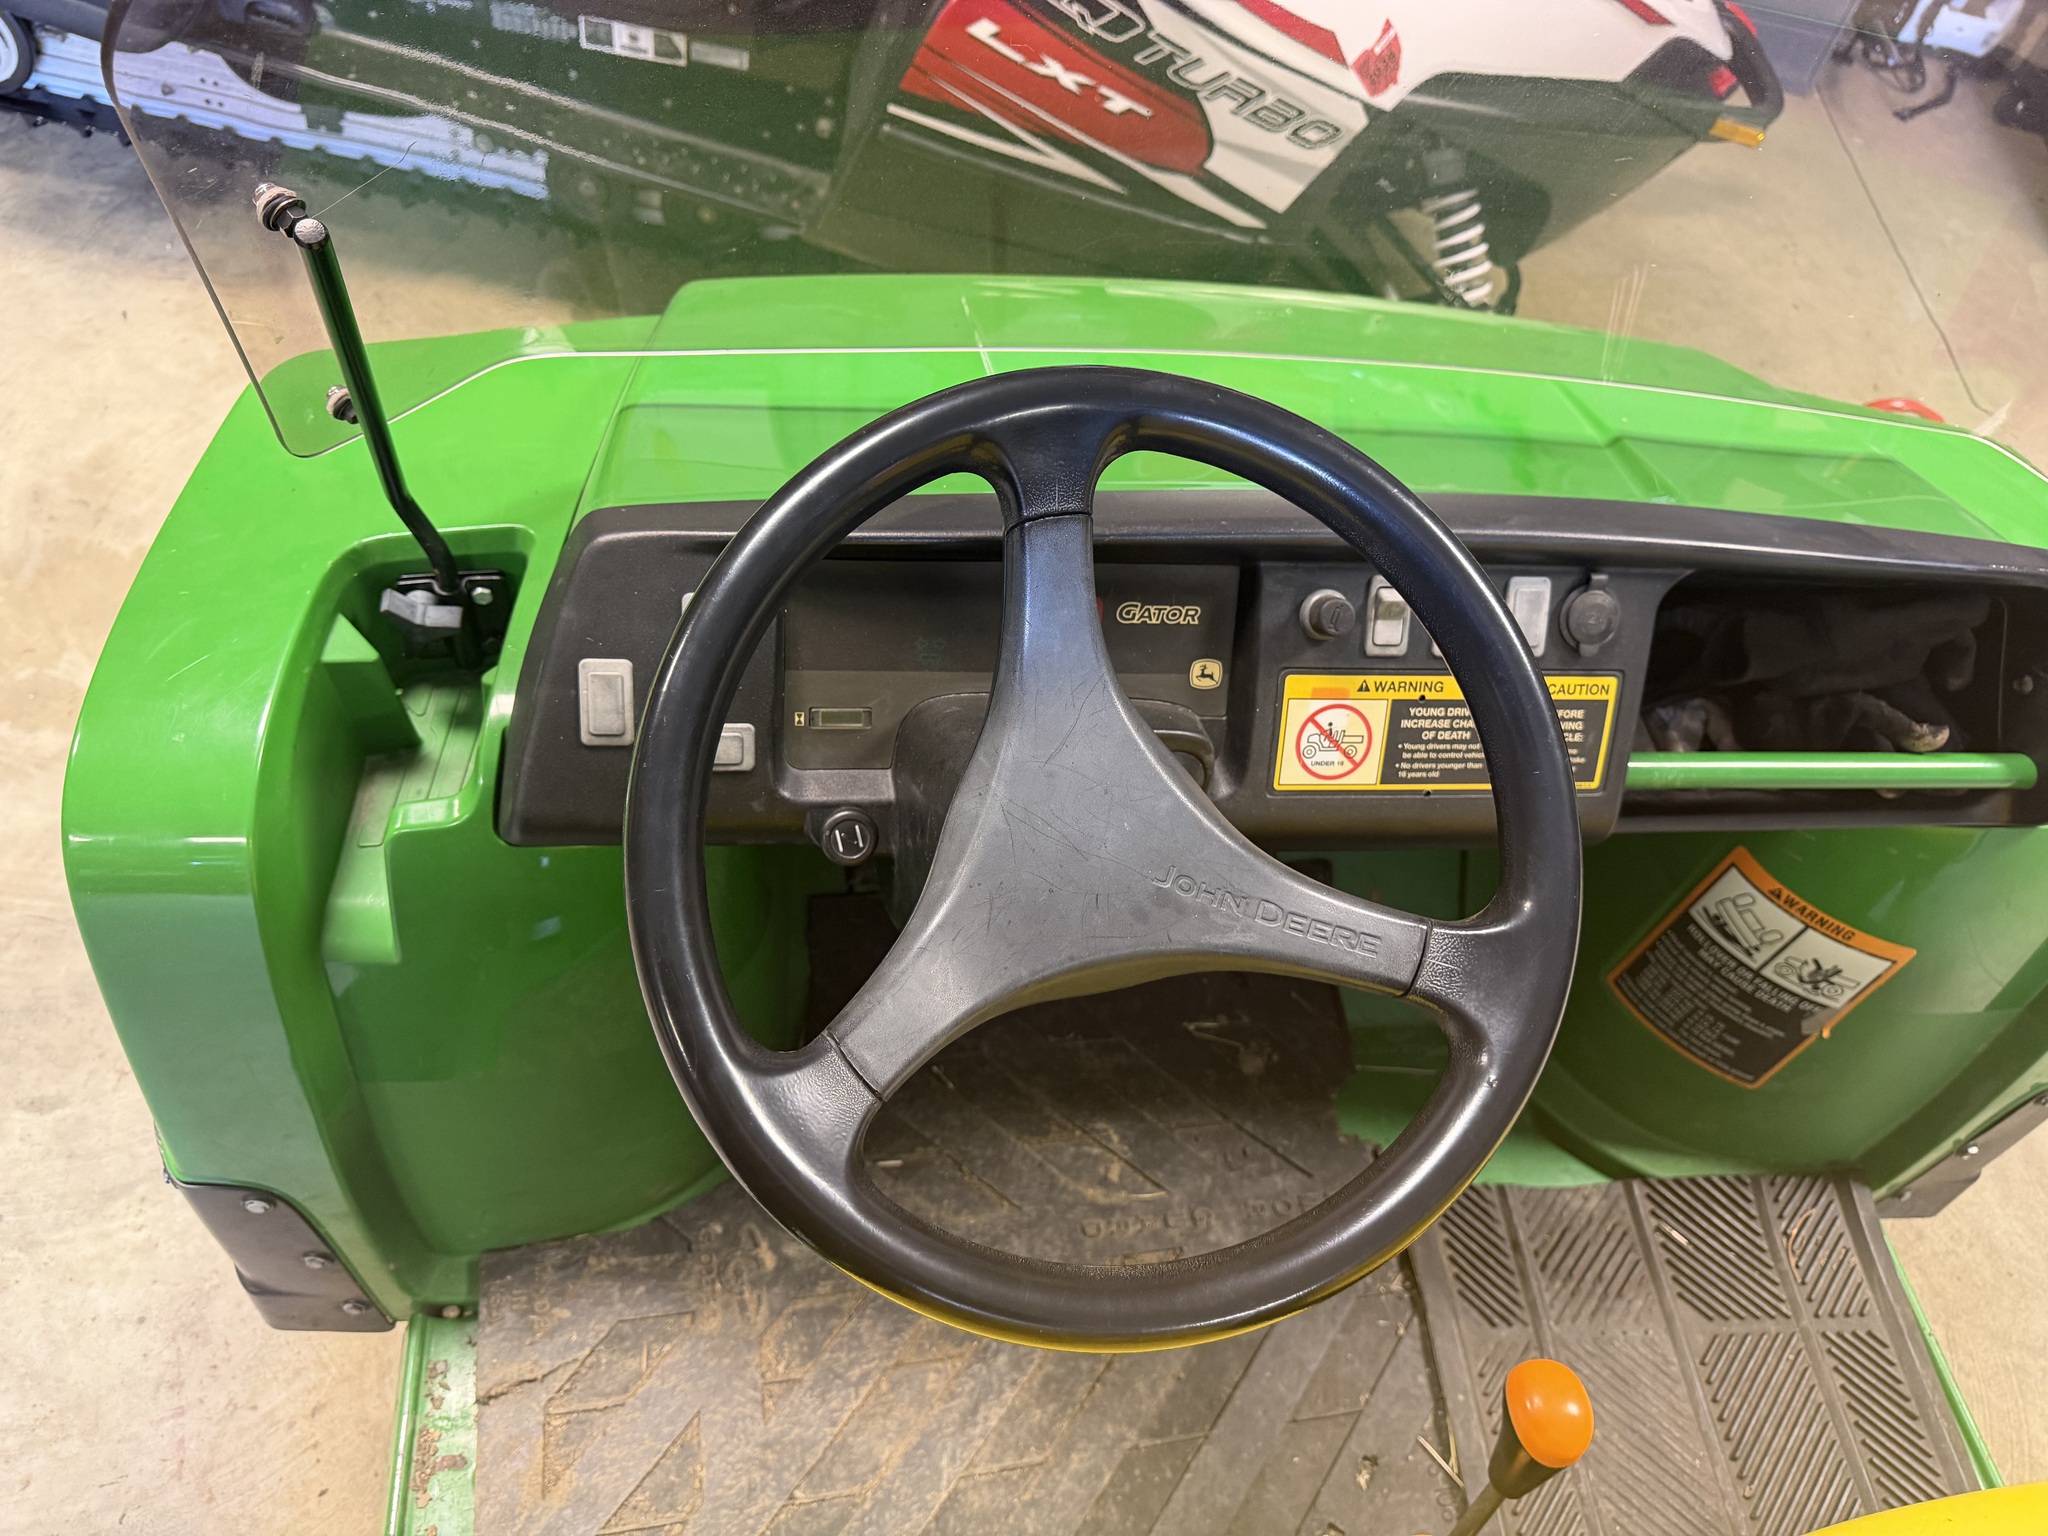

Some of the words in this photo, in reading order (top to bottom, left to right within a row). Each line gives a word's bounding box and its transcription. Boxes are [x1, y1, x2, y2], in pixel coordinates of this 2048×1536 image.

[965, 17, 1154, 118] LXT
[1133, 30, 1344, 150] TURBO
[1116, 602, 1201, 625] GATOR
[1373, 680, 1444, 693] WARNING
[1548, 684, 1610, 695] CAUTION
[1409, 707, 1446, 717] YOUNG
[1447, 707, 1471, 717] DRIV
[1400, 719, 1451, 729] INCREASE
[1452, 719, 1475, 729] CHA
[1421, 730, 1437, 741] OF
[1437, 730, 1471, 741] DEATH
[1403, 743, 1426, 751] Young
[1437, 762, 1466, 771] younger
[1152, 865, 1247, 918] JOHN
[1255, 900, 1382, 958] DEERE
[1783, 894, 1856, 941] WARNING
[1687, 923, 1737, 968] ROLLOVER
[1736, 966, 1755, 980] OR
[1752, 977, 1800, 1007] FALLING
[1697, 948, 1722, 970] MAY
[1720, 965, 1758, 995] CAUSE
[1754, 989, 1793, 1014] DEATH
